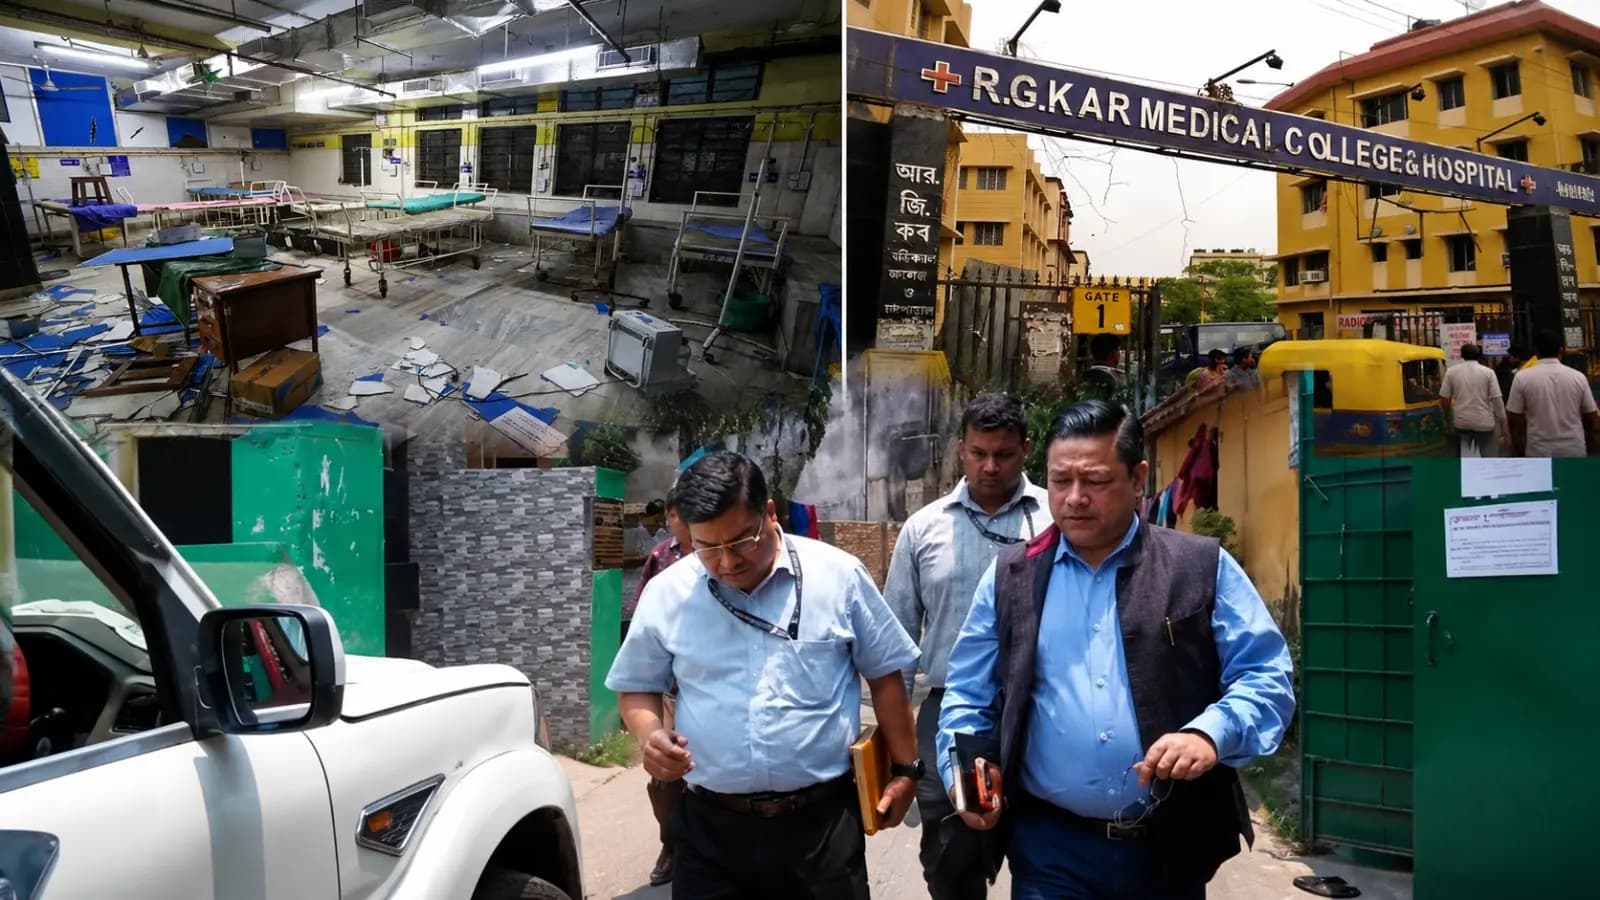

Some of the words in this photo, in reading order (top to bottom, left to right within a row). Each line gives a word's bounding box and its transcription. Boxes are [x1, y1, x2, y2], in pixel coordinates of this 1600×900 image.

[1140, 97, 1279, 153] MEDICAL
[1084, 291, 1120, 303] GATE
[1096, 304, 1105, 329] 1
